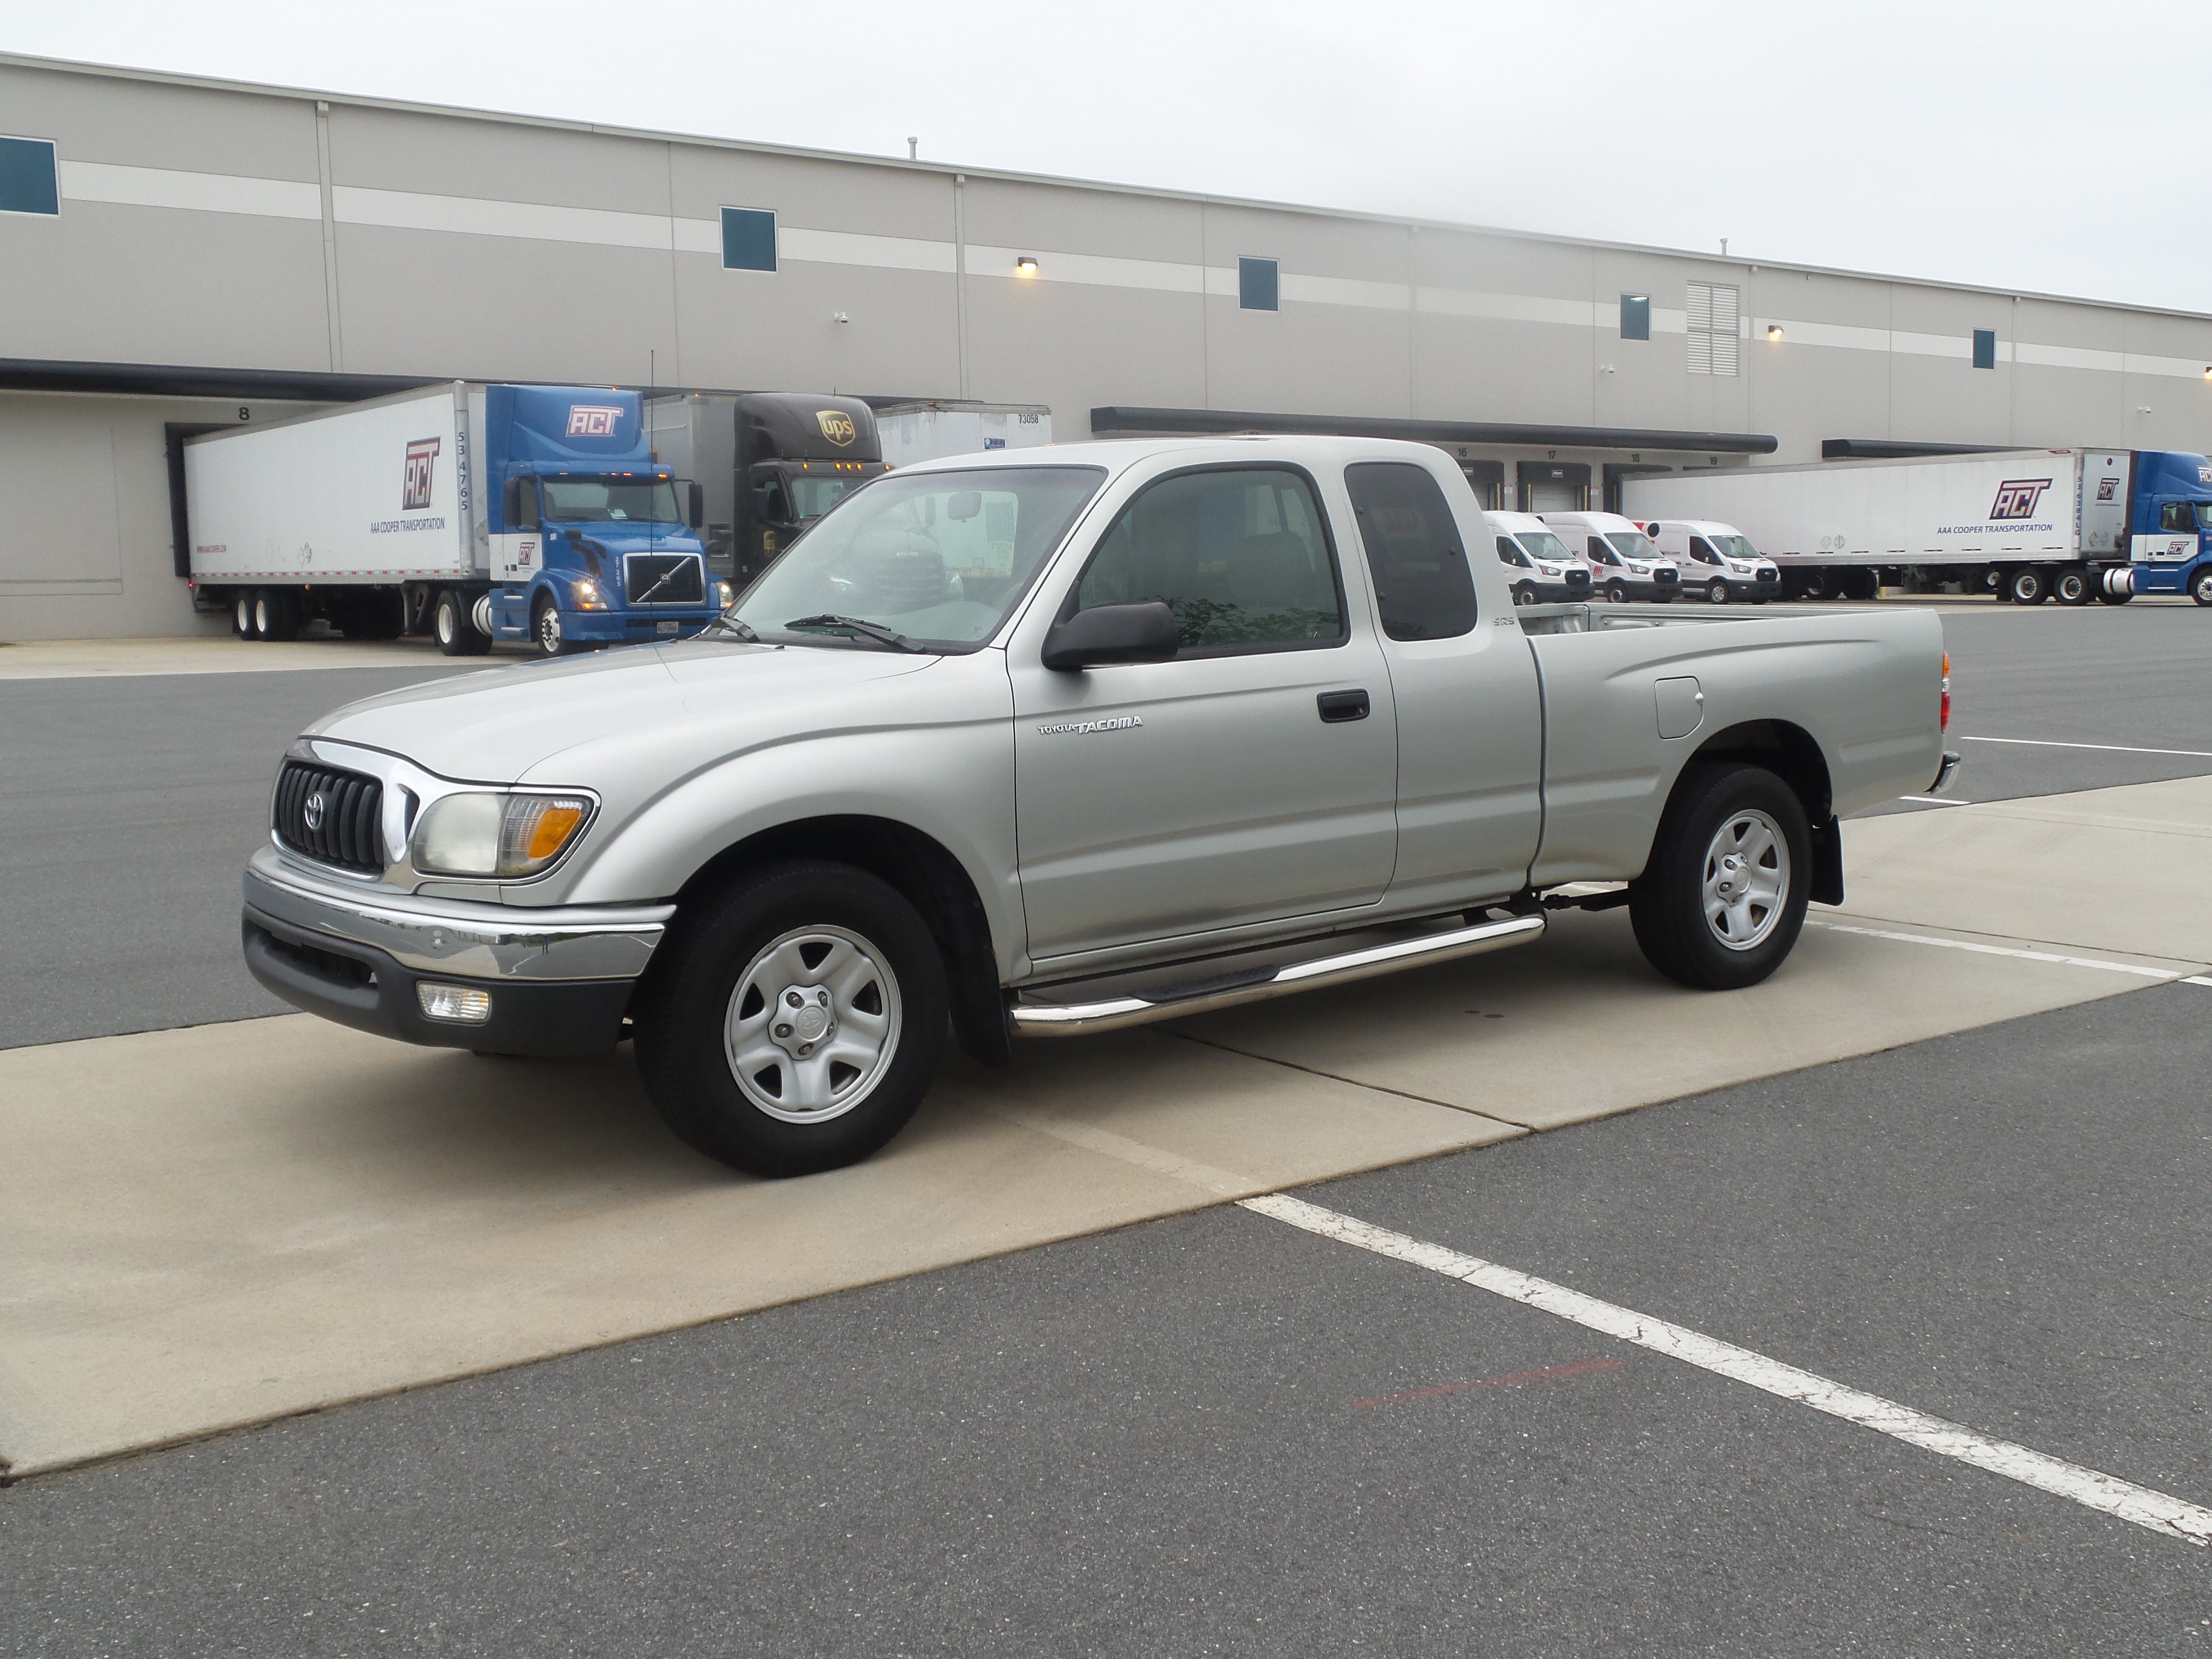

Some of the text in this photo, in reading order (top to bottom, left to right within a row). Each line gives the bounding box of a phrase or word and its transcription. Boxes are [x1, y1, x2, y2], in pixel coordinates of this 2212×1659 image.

[239, 407, 250, 421] 8
[567, 406, 623, 436] ACT
[1018, 414, 1039, 424] 73058
[822, 420, 853, 440] ups
[1458, 447, 1467, 457] 16
[1548, 450, 1556, 459] 17
[1632, 454, 1640, 462] 18
[1710, 457, 1717, 465] 19
[402, 436, 441, 510] ACT
[2097, 478, 2120, 500] ACT
[1990, 479, 2052, 519] ACT
[370, 517, 445, 533] AAA COOPER TRANSPORTATION
[1984, 524, 2053, 533] TRANSPORTATION
[2166, 541, 2189, 554] ACT
[1038, 716, 1143, 734] TOYOTA TACOMA
